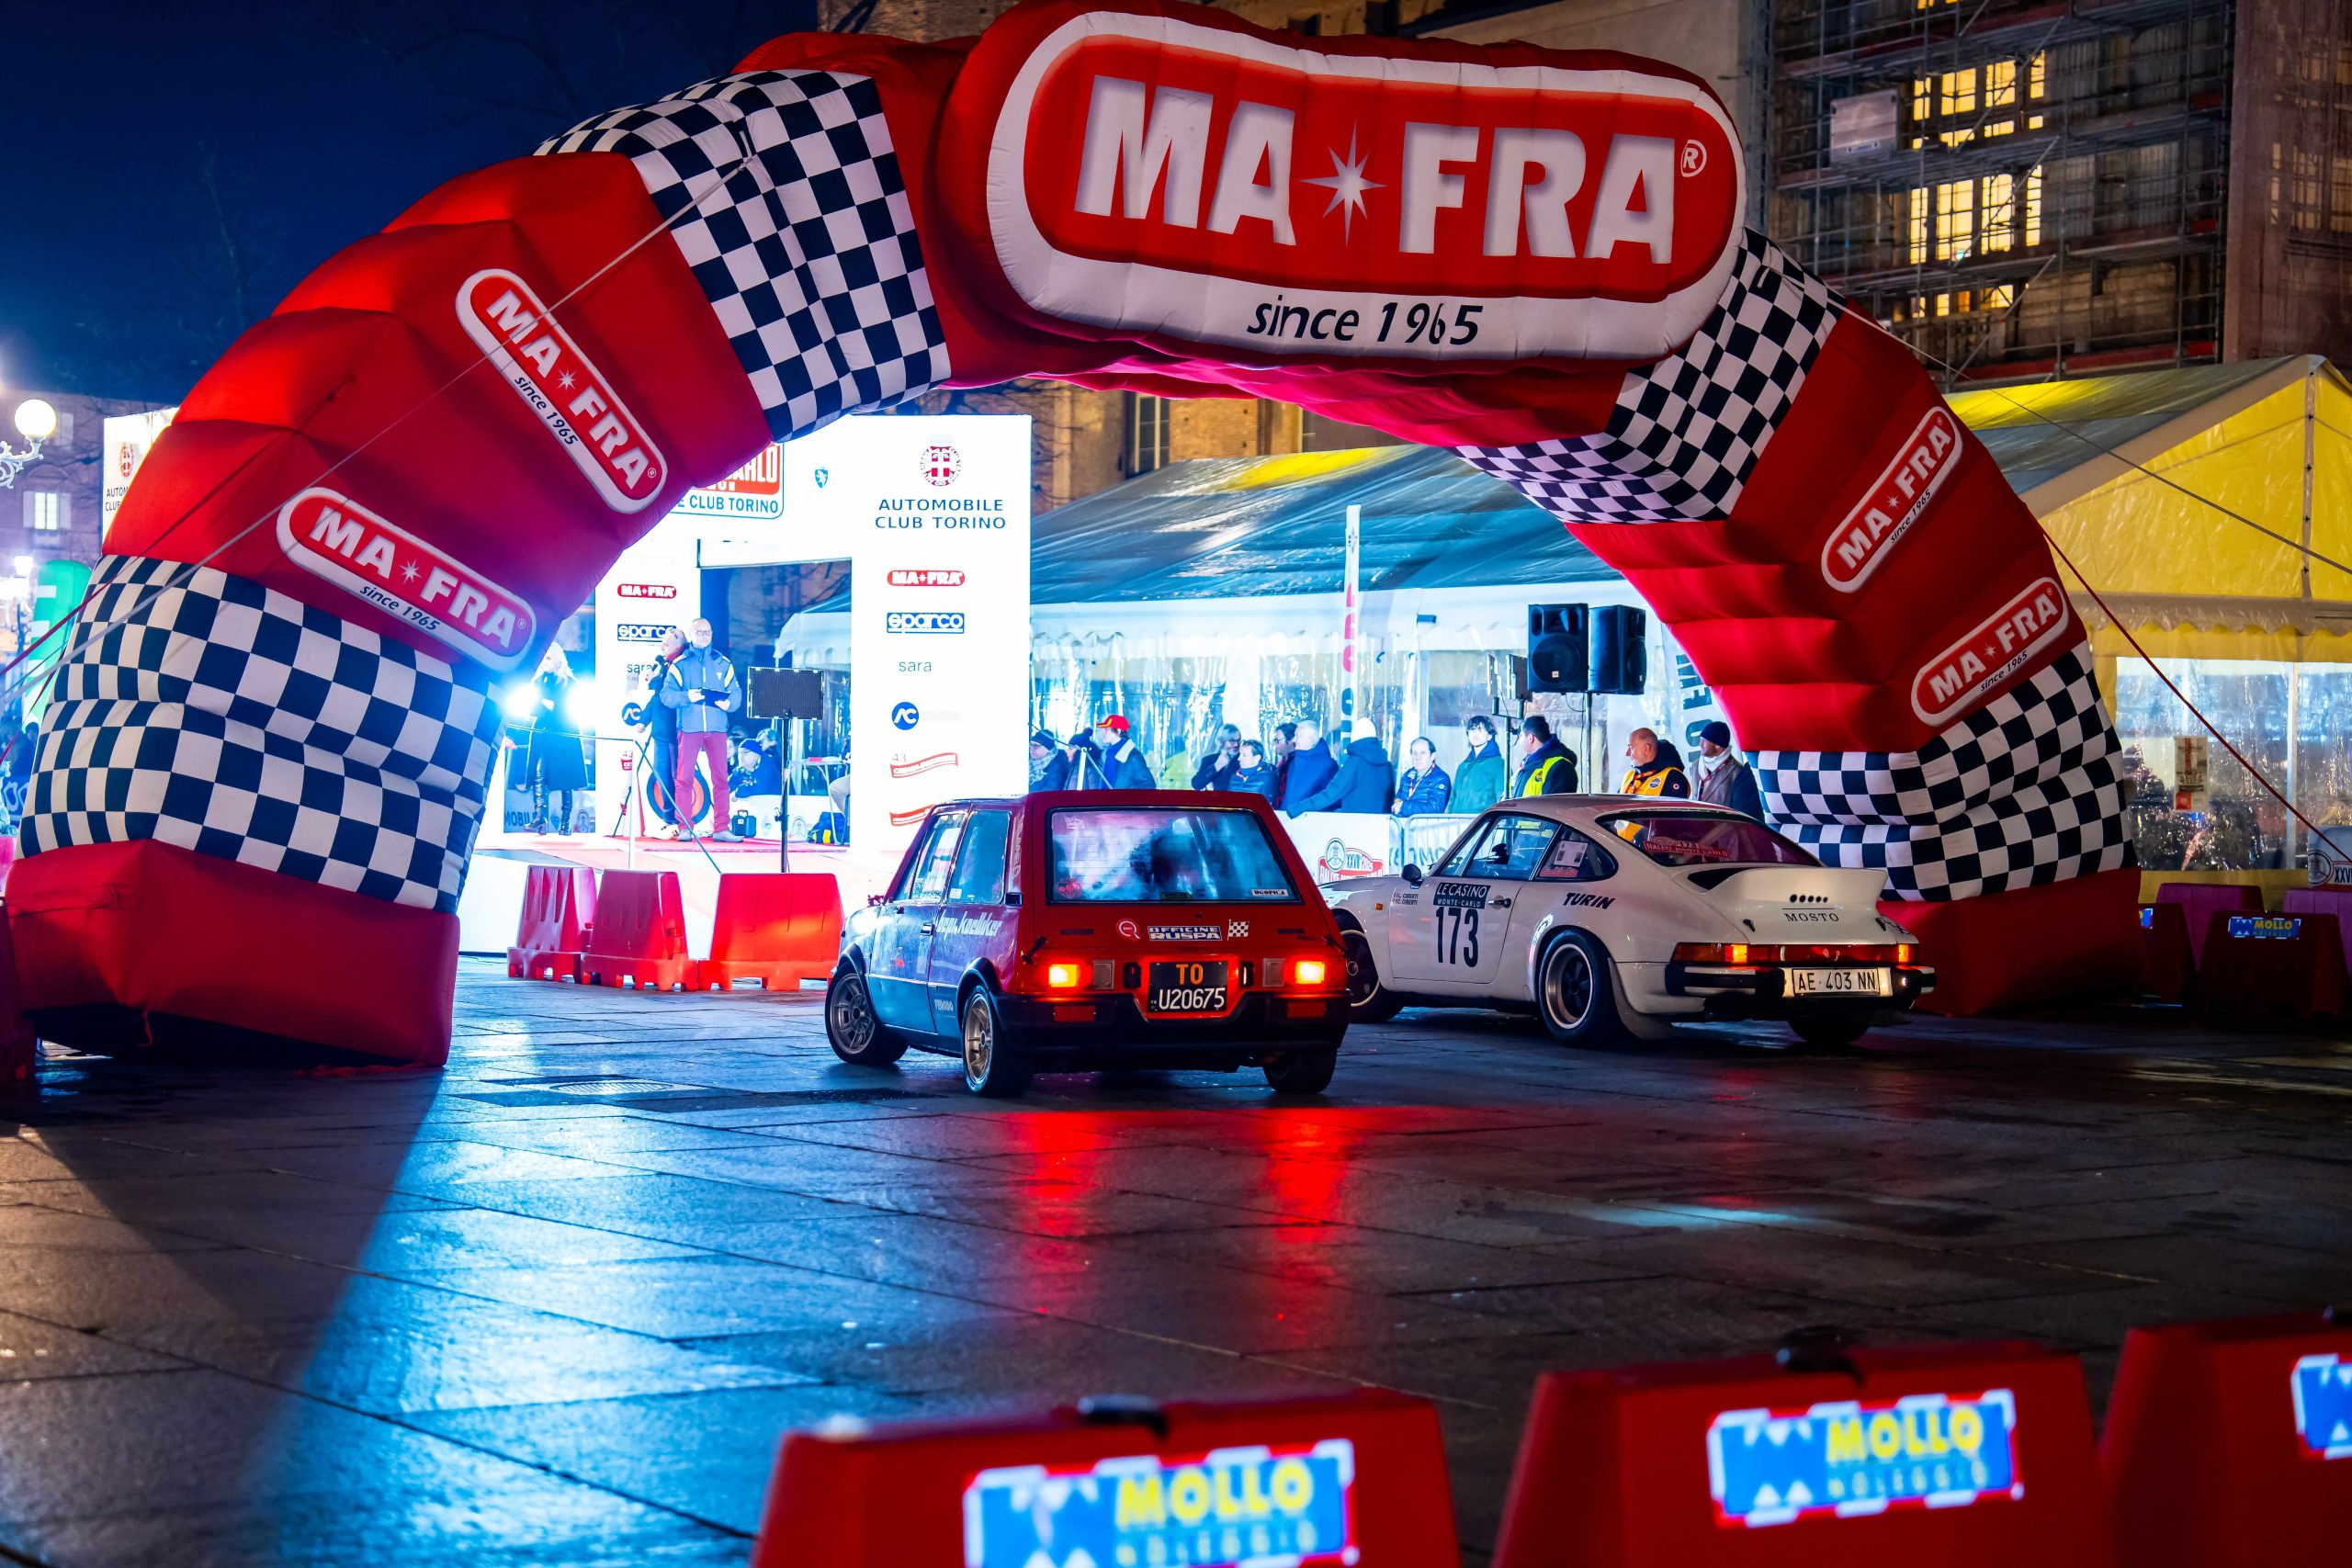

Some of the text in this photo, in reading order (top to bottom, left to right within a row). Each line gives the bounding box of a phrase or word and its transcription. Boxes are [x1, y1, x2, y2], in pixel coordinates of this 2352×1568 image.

[1248, 295, 1483, 346] since 1965
[514, 376, 579, 446] since 1965
[689, 494, 725, 510] CLUB
[729, 497, 778, 513] TORINO
[878, 499, 1003, 511] AUTOMOBILE
[875, 516, 1006, 529] CLUB TORINO
[1890, 488, 1931, 544] since 1965
[359, 584, 440, 631] since 1965
[888, 613, 964, 633] sparco
[899, 660, 932, 672] sara
[1980, 649, 2028, 692] since 1965
[505, 810, 539, 827] MOBIL
[1563, 892, 1616, 910] TURIN
[1783, 912, 1839, 922] MOSTO
[2254, 919, 2293, 930] MOLLO
[1435, 906, 1479, 968] 173
[1175, 964, 1204, 986] TO
[1159, 987, 1226, 1010] U20675
[1826, 1406, 1984, 1465] MOLLO
[1115, 1457, 1314, 1532] MOLLO
